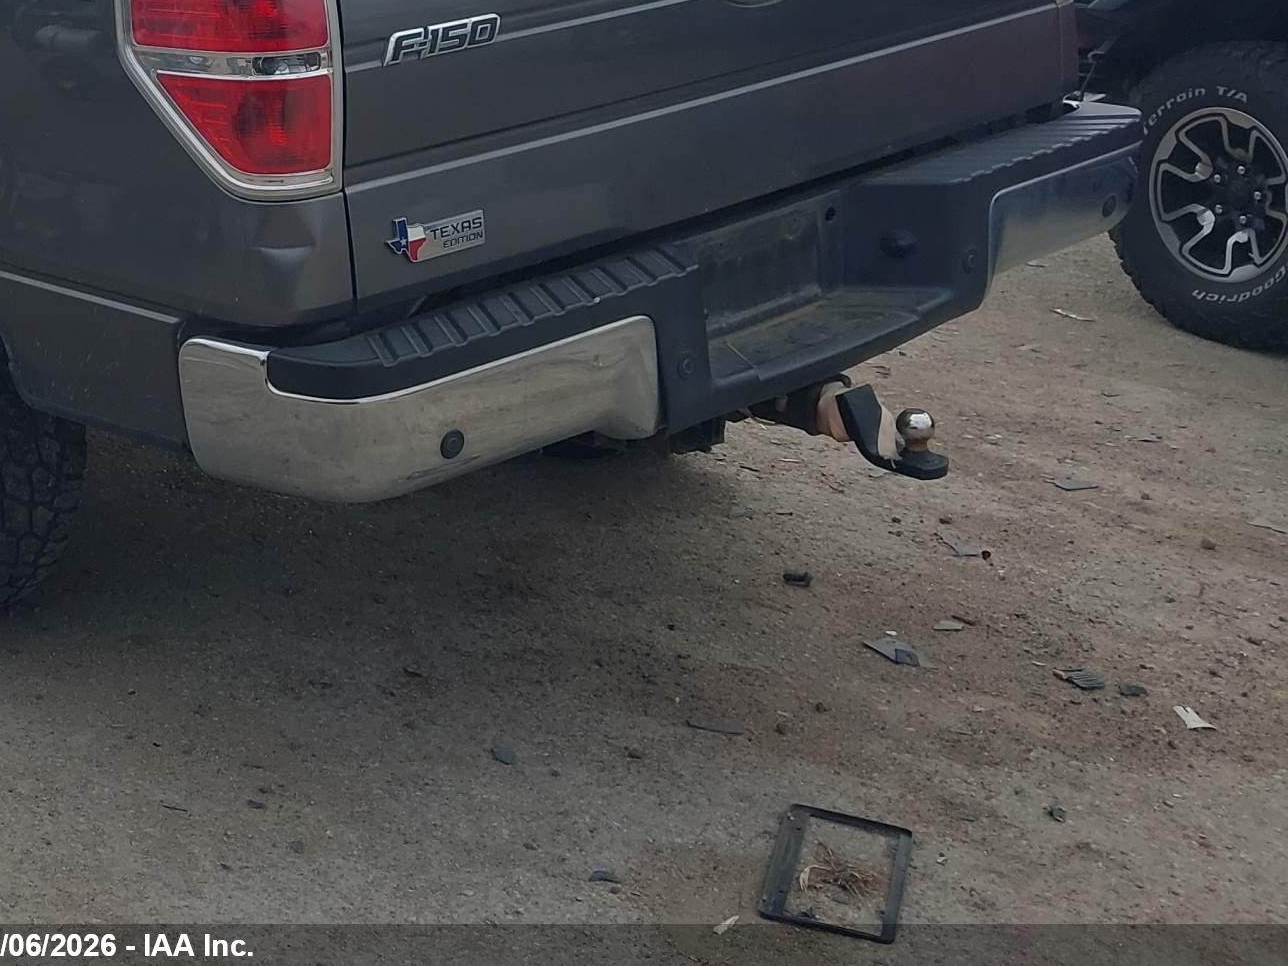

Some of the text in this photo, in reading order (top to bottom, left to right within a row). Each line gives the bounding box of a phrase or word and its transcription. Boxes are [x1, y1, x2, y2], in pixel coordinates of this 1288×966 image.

[383, 13, 501, 67] F-150
[1216, 85, 1248, 103] T/A
[430, 216, 483, 240] TEXAS
[443, 230, 483, 249] EDITION
[1192, 263, 1288, 304] Goodrich
